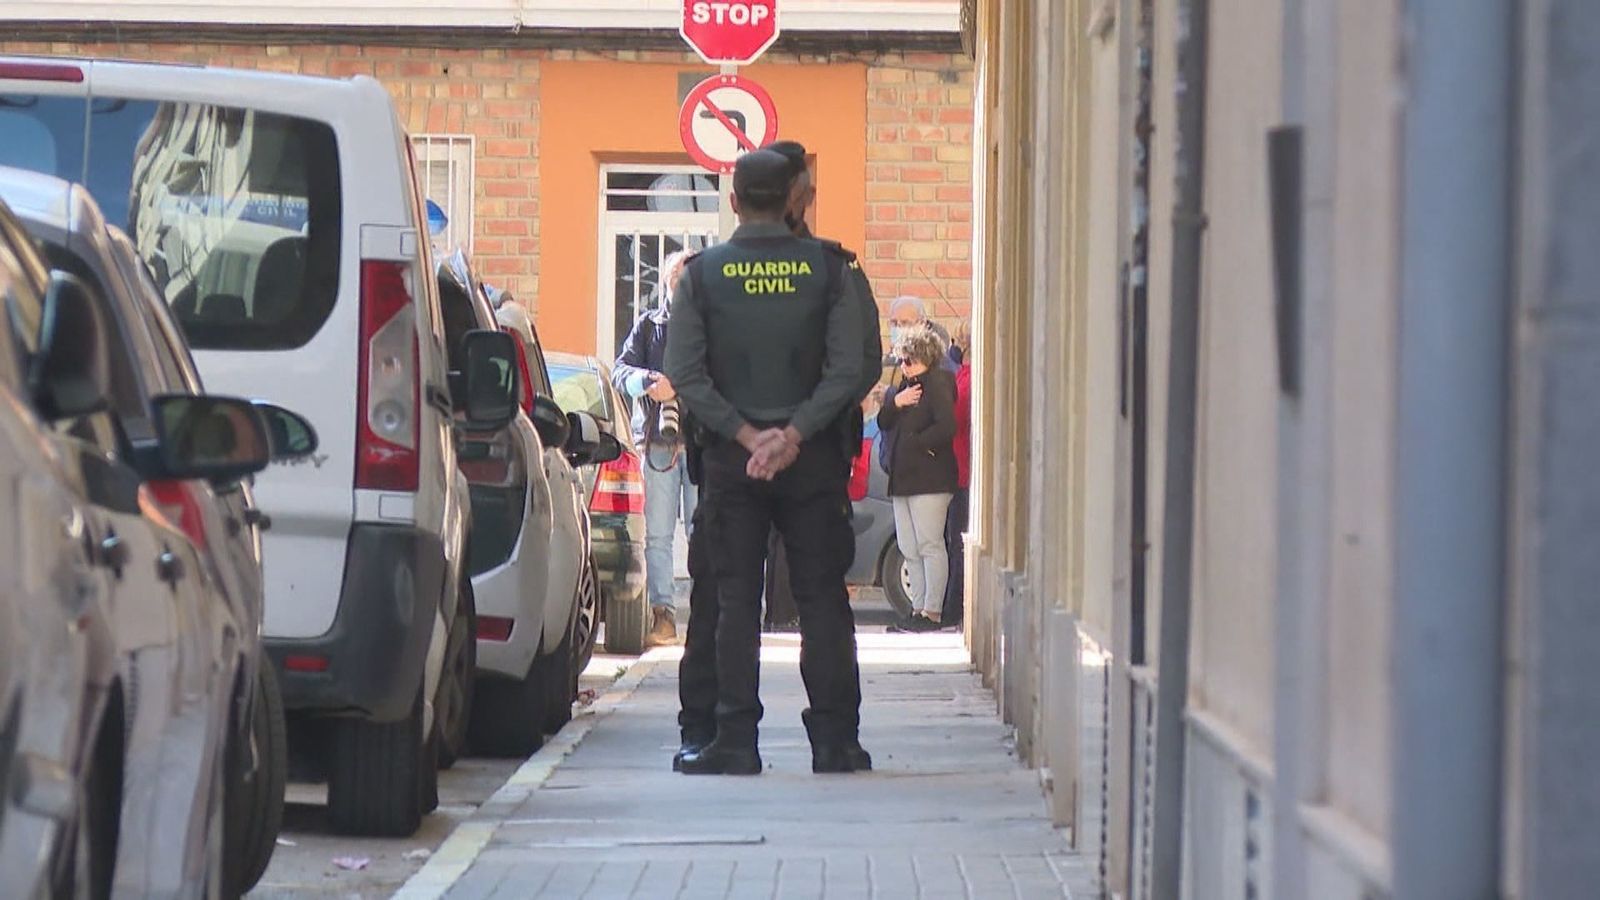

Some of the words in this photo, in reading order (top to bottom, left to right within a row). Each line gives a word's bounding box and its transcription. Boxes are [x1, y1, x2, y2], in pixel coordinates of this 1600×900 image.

[692, 3, 769, 26] STOP
[722, 261, 812, 277] GUARDIA
[744, 278, 796, 294] CIVIL
